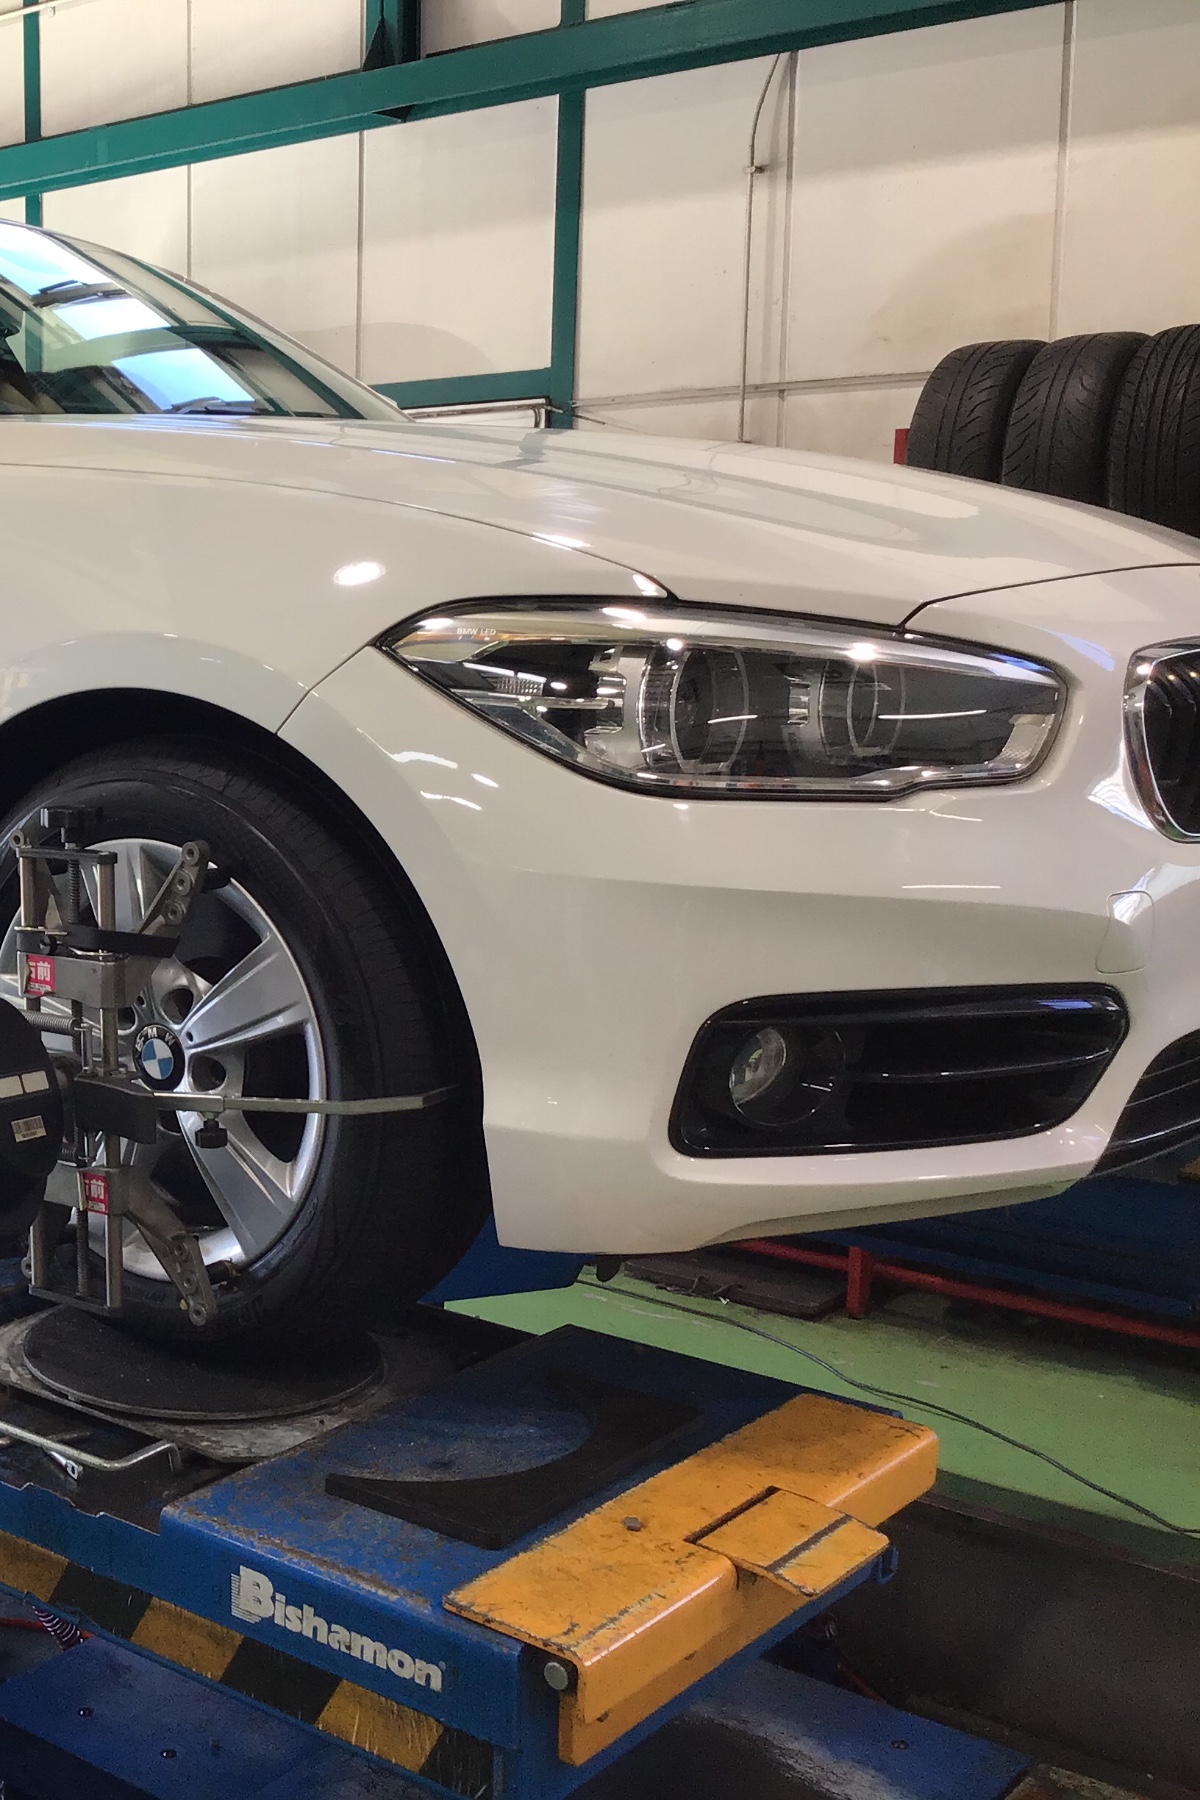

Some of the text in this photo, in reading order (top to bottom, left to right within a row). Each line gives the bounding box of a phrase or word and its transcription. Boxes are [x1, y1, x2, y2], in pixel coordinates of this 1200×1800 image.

[456, 627, 497, 636] BMW LED
[135, 1026, 176, 1052] BMW
[231, 1565, 443, 1693] Bishamon
